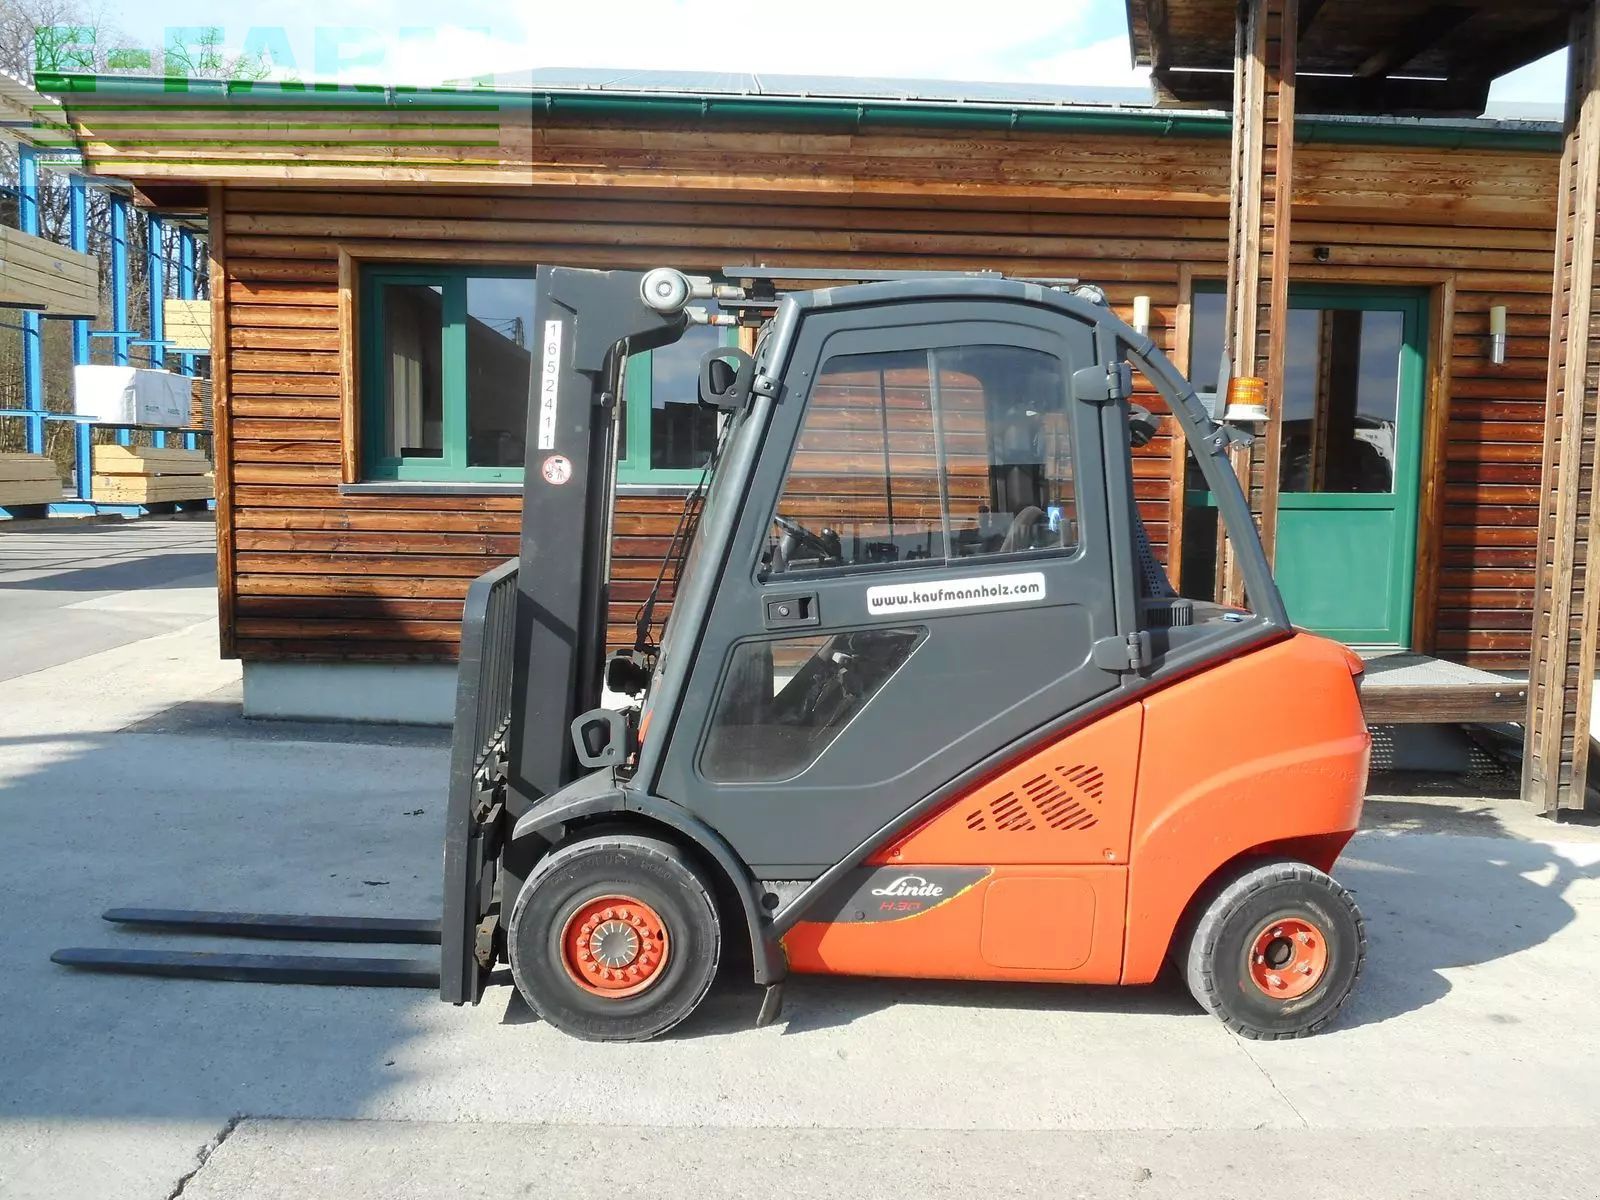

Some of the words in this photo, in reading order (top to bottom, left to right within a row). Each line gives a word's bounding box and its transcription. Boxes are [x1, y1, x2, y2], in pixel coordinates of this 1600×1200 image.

[543, 323, 557, 447] 1652411
[872, 583, 1040, 607] www.kaufmannholz.com
[871, 875, 943, 897] Linde
